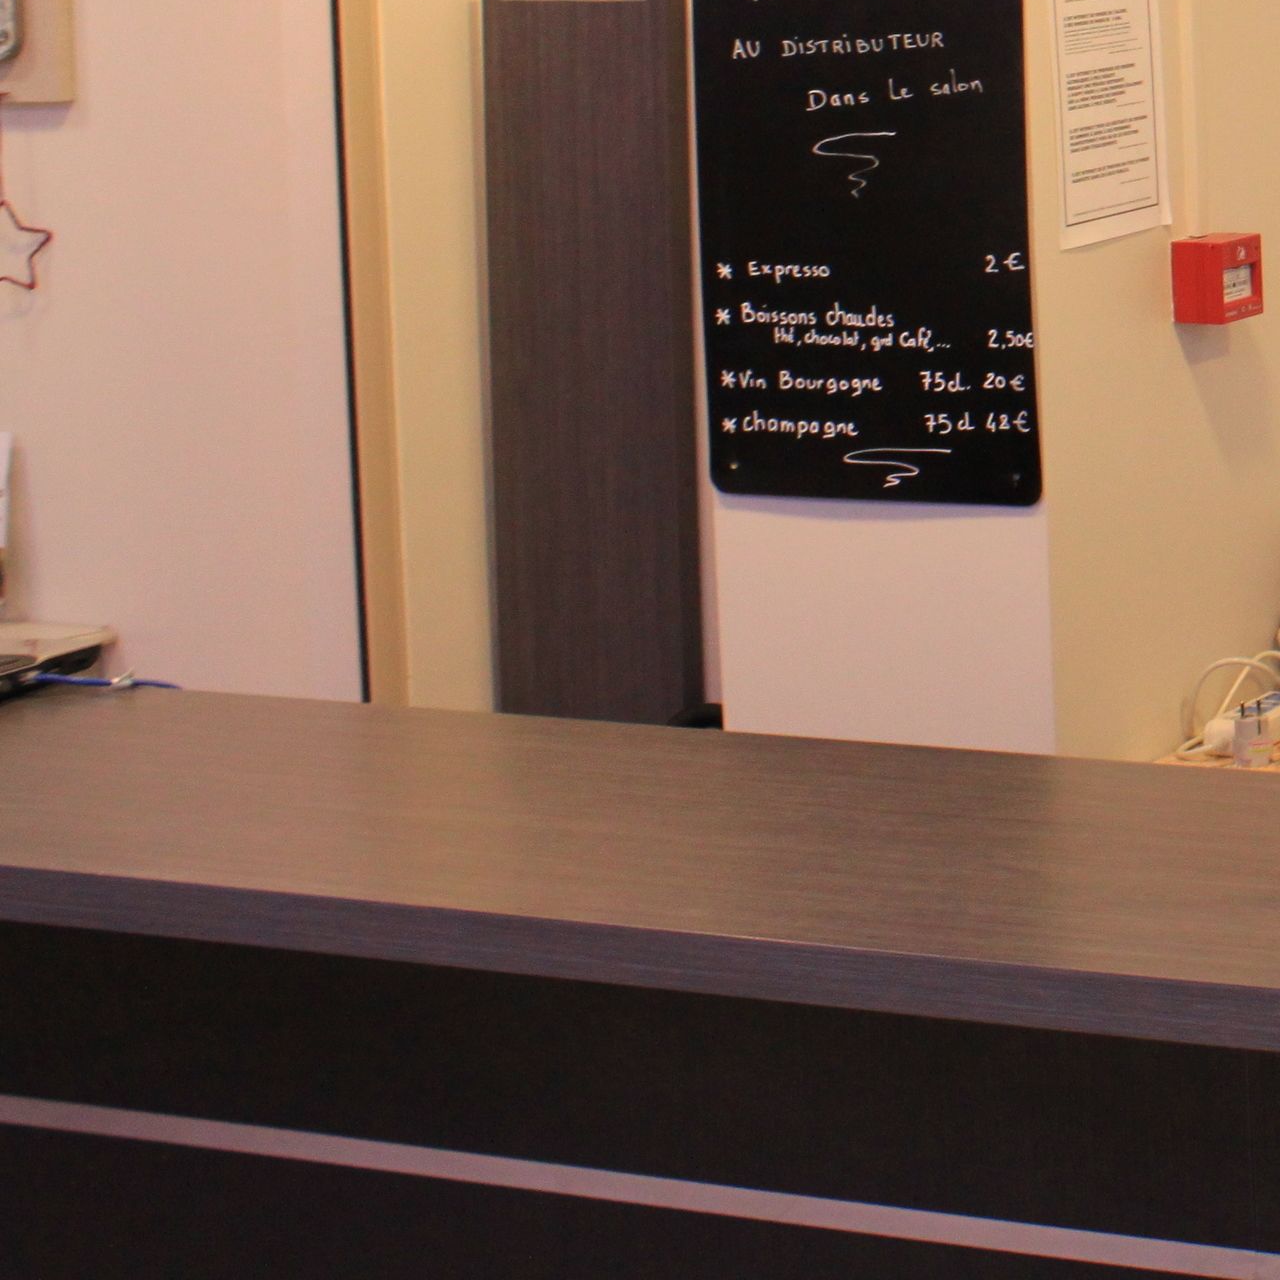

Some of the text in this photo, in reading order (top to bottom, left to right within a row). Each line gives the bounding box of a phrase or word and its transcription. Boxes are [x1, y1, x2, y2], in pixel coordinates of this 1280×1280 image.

[732, 38, 761, 59] AU
[806, 89, 869, 111] Dans
[930, 69, 983, 98] salon
[748, 261, 831, 284] Expresso
[741, 302, 894, 328] Boissons chaudes
[739, 370, 767, 389] Vin
[779, 370, 882, 397] Bourgogne
